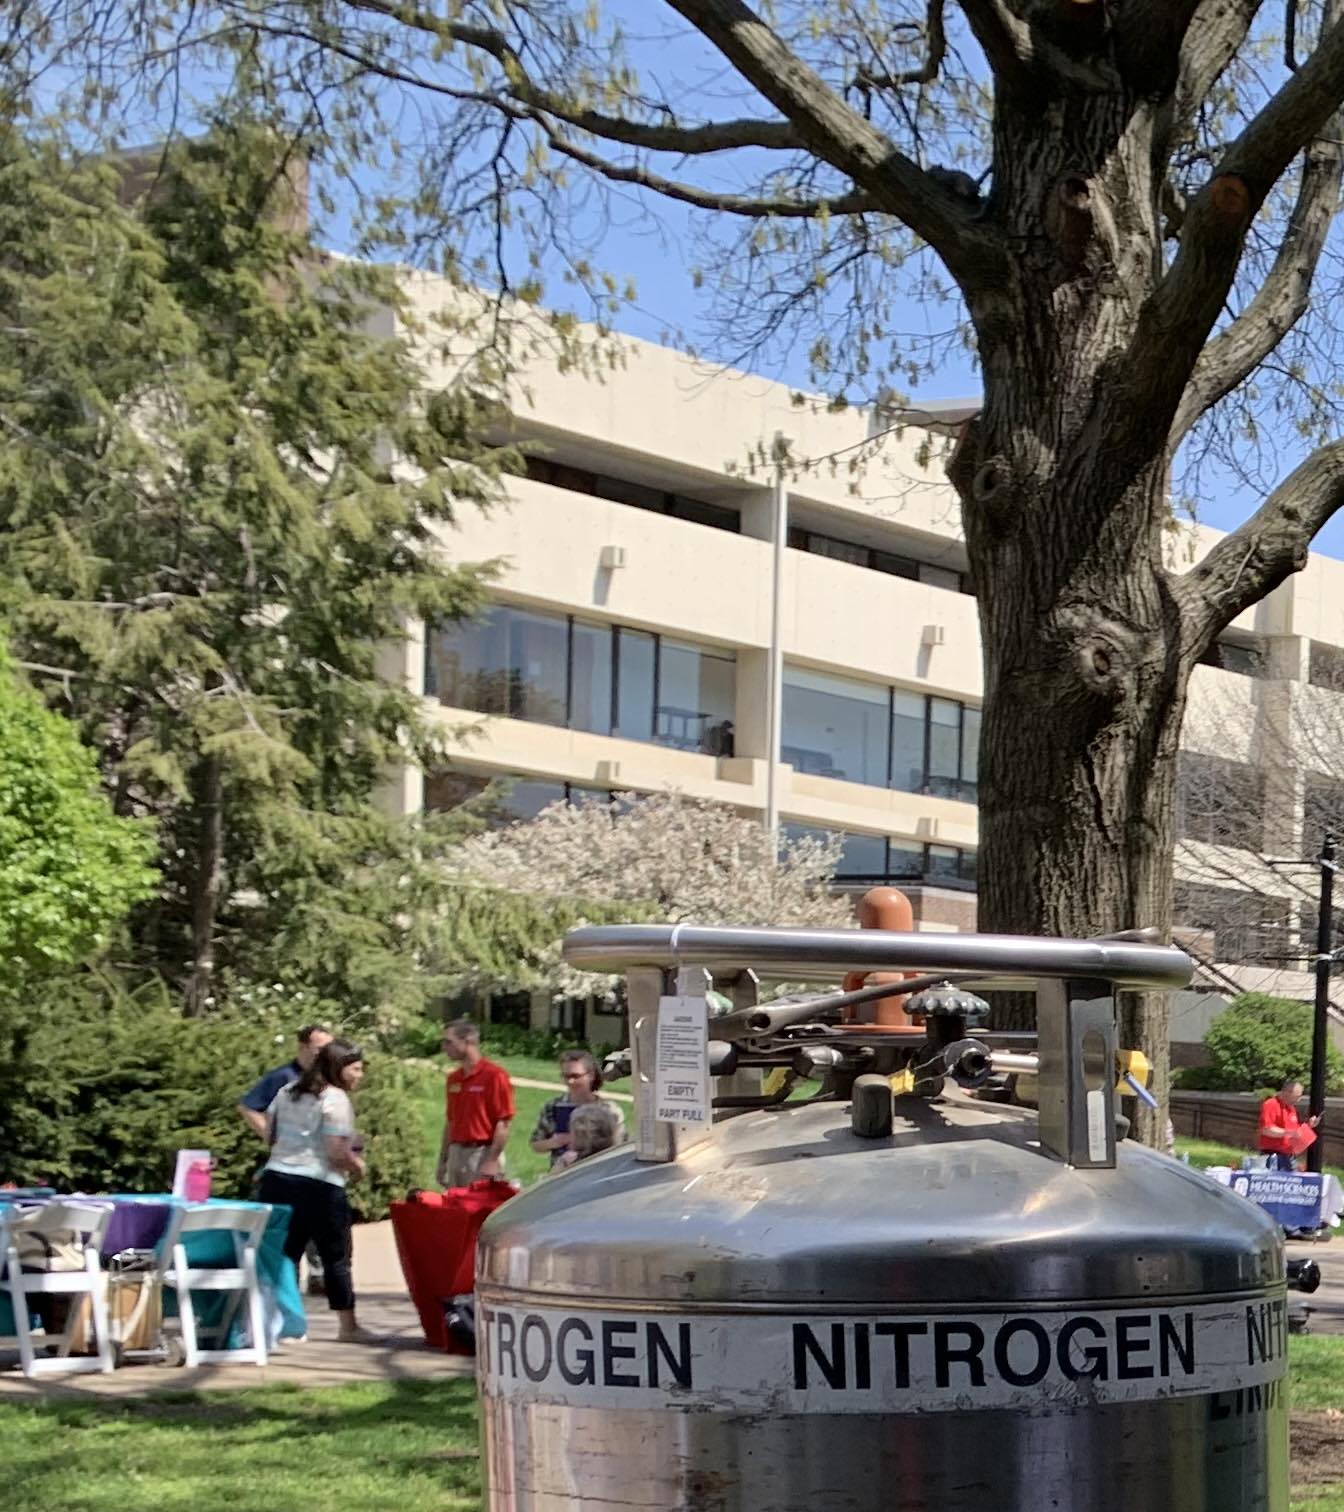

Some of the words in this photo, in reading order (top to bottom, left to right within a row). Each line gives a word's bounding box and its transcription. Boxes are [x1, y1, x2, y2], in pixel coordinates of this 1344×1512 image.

[667, 1085, 695, 1097] EMPTY
[792, 1312, 1196, 1391] NITROGEN
[1246, 1300, 1288, 1366] NIT
